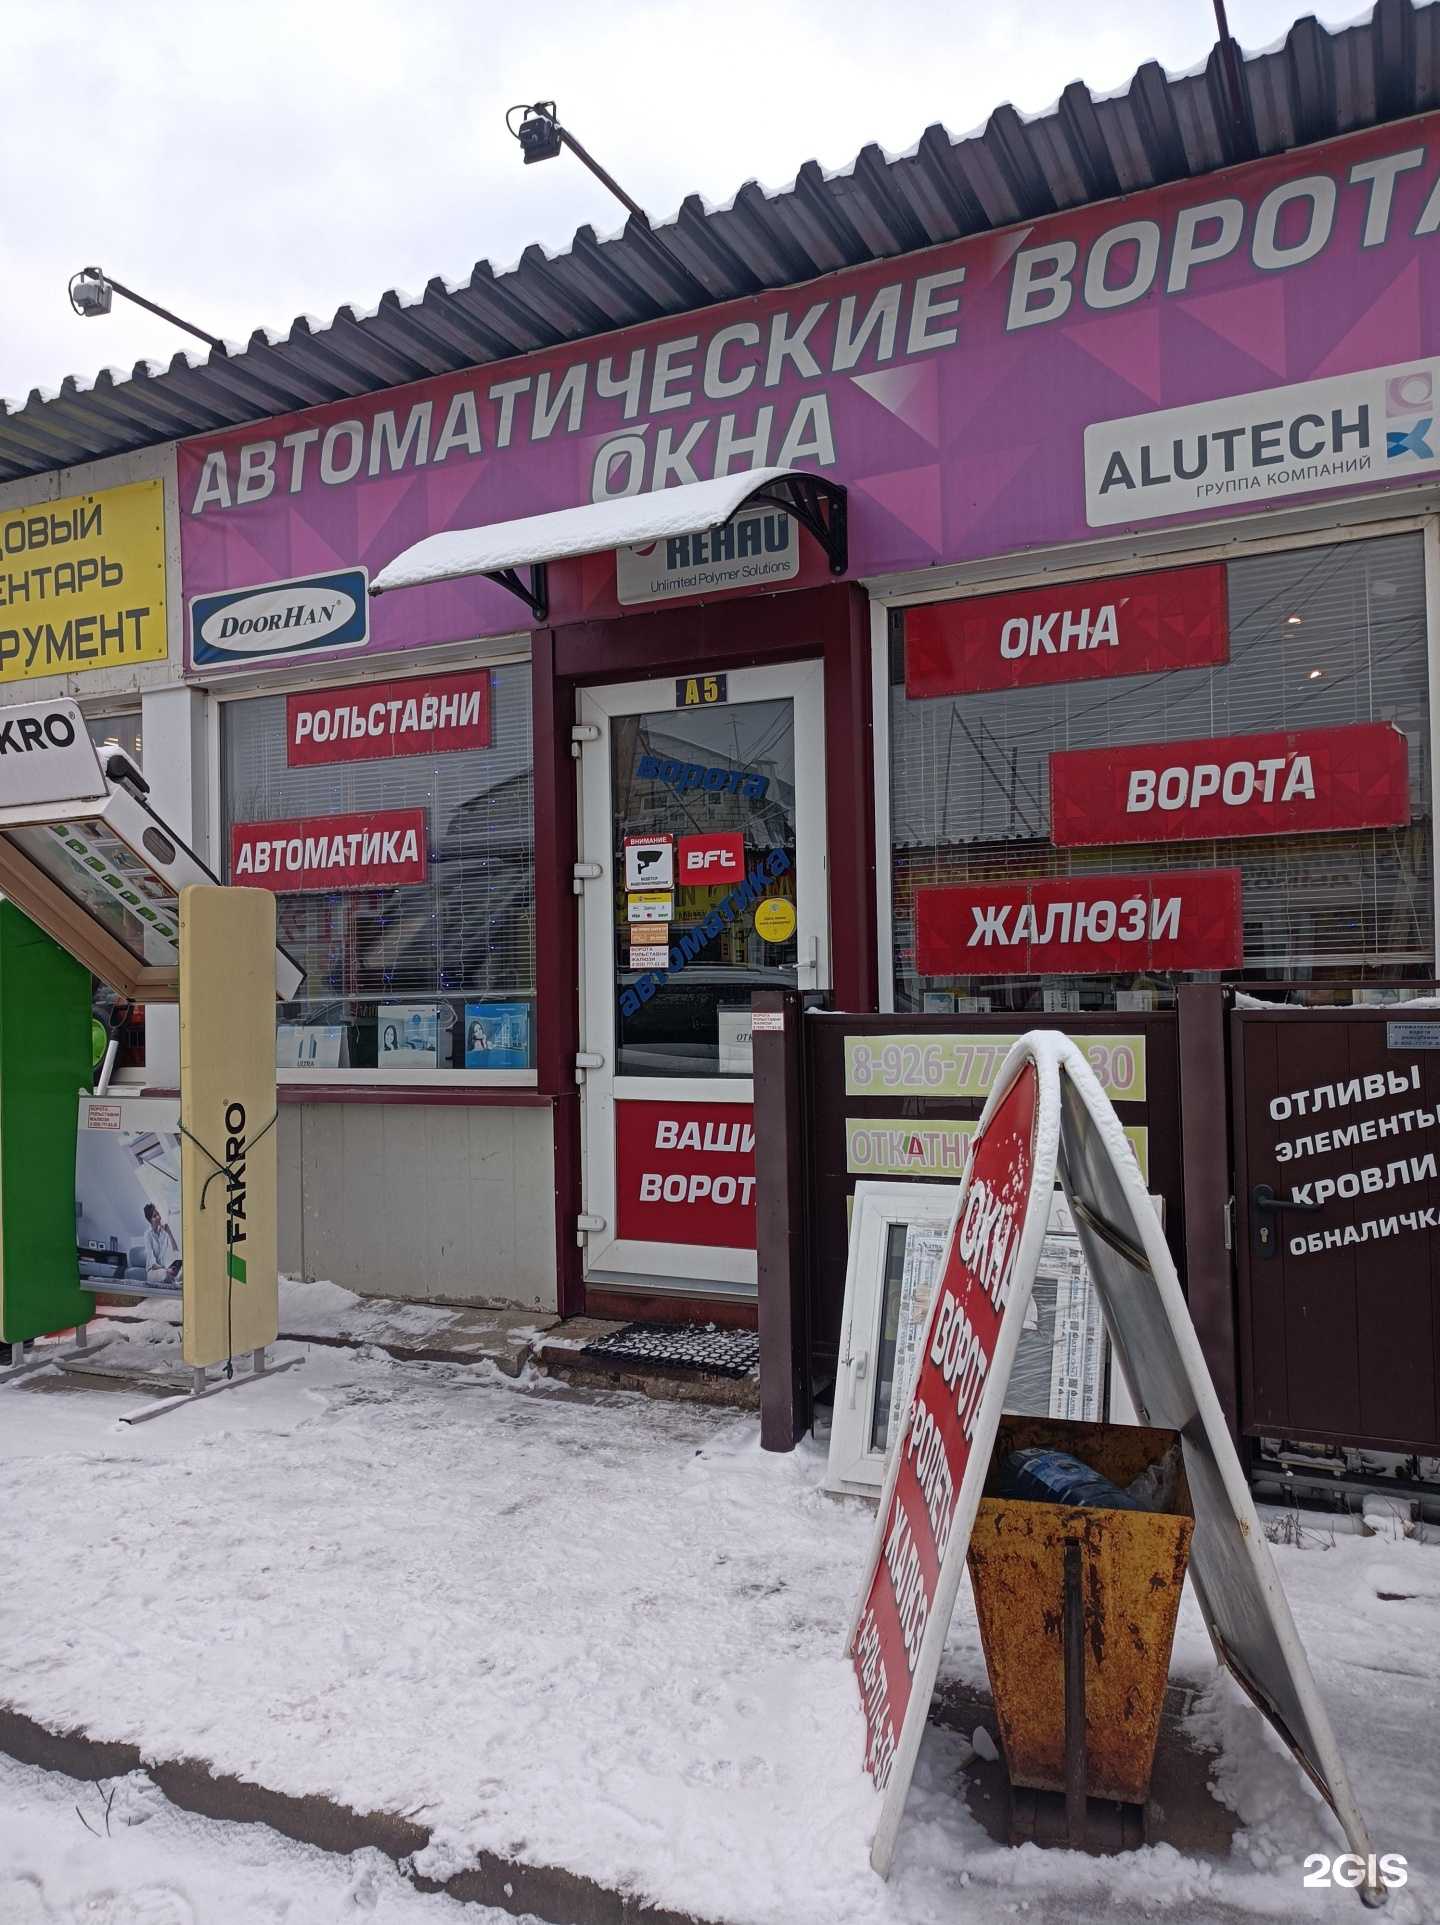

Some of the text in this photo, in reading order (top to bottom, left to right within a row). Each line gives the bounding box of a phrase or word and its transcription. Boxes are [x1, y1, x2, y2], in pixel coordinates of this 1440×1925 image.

[192, 267, 966, 514] АВТОМАТИЧЕСКИЕ
[592, 393, 836, 504] ОКНА
[1099, 404, 1370, 495] ALUTECH
[1196, 455, 1372, 498] ГРУППА КОМПАНИЙ
[0, 497, 102, 560] ОВЫЙ
[666, 512, 790, 570] REHAU
[650, 560, 791, 593] Unlimited Polymer Solutions
[1000, 605, 1120, 660] ОКНА
[0, 713, 76, 755] KRO
[295, 690, 481, 745] РОЛЬСТАВНИ
[1126, 756, 1316, 813] ВОРОТА
[236, 828, 418, 875] АВТОМАТИКА
[630, 836, 667, 845] ВНИМАНИЕ
[967, 896, 1182, 946] ЖАЛЮЗИ
[1269, 1065, 1421, 1121] ОТЛИВЫ
[1275, 1104, 1440, 1163] ЭЛЕМЕНТЫ
[225, 1101, 247, 1244] FAKRO
[639, 1173, 757, 1207] ВОРОТ
[1291, 1153, 1438, 1205] КРОВЛИ
[959, 1179, 1021, 1313] ОКНА
[1289, 1208, 1440, 1256] ОБНАЛИЧК
[885, 1494, 929, 1673] ЖАЛЮЗ
